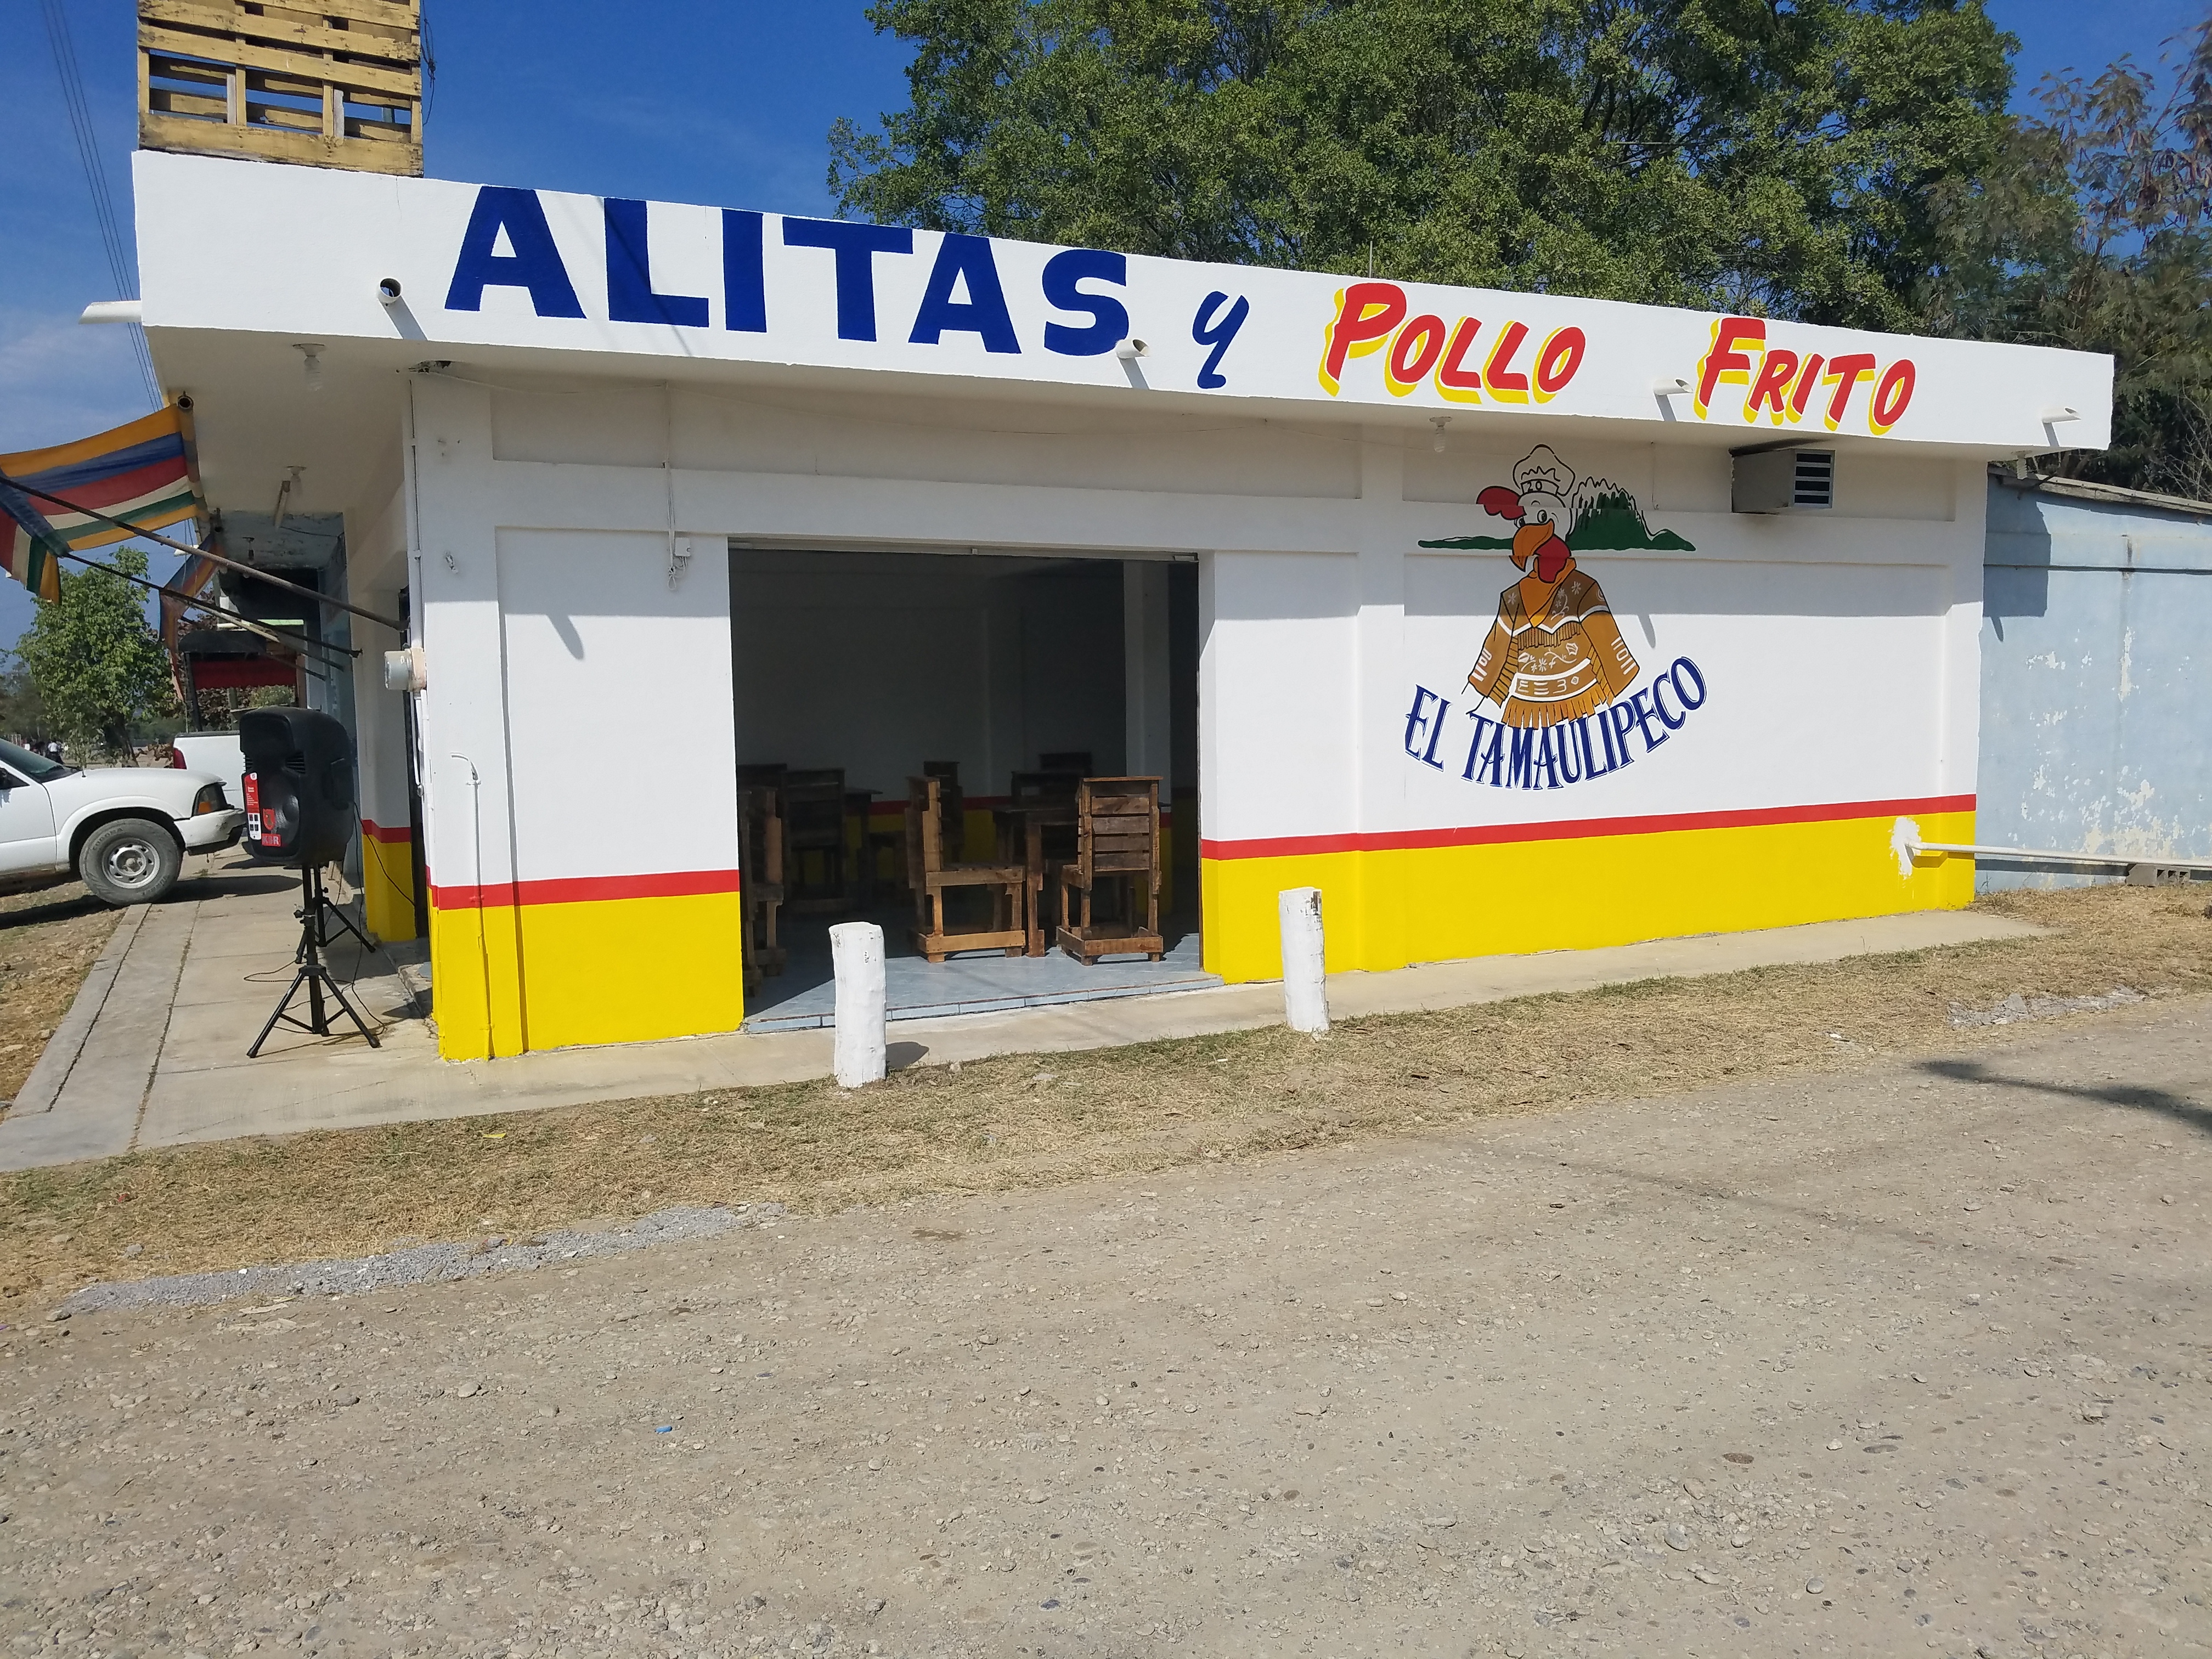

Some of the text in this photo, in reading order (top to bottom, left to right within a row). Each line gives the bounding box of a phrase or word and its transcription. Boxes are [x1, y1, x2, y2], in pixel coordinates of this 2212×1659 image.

[445, 185, 1130, 357] ALITAS
[1318, 283, 1587, 405] POLLO
[1693, 317, 1916, 436] FRITO
[1405, 655, 1707, 790] EL TAMAULIPECO
